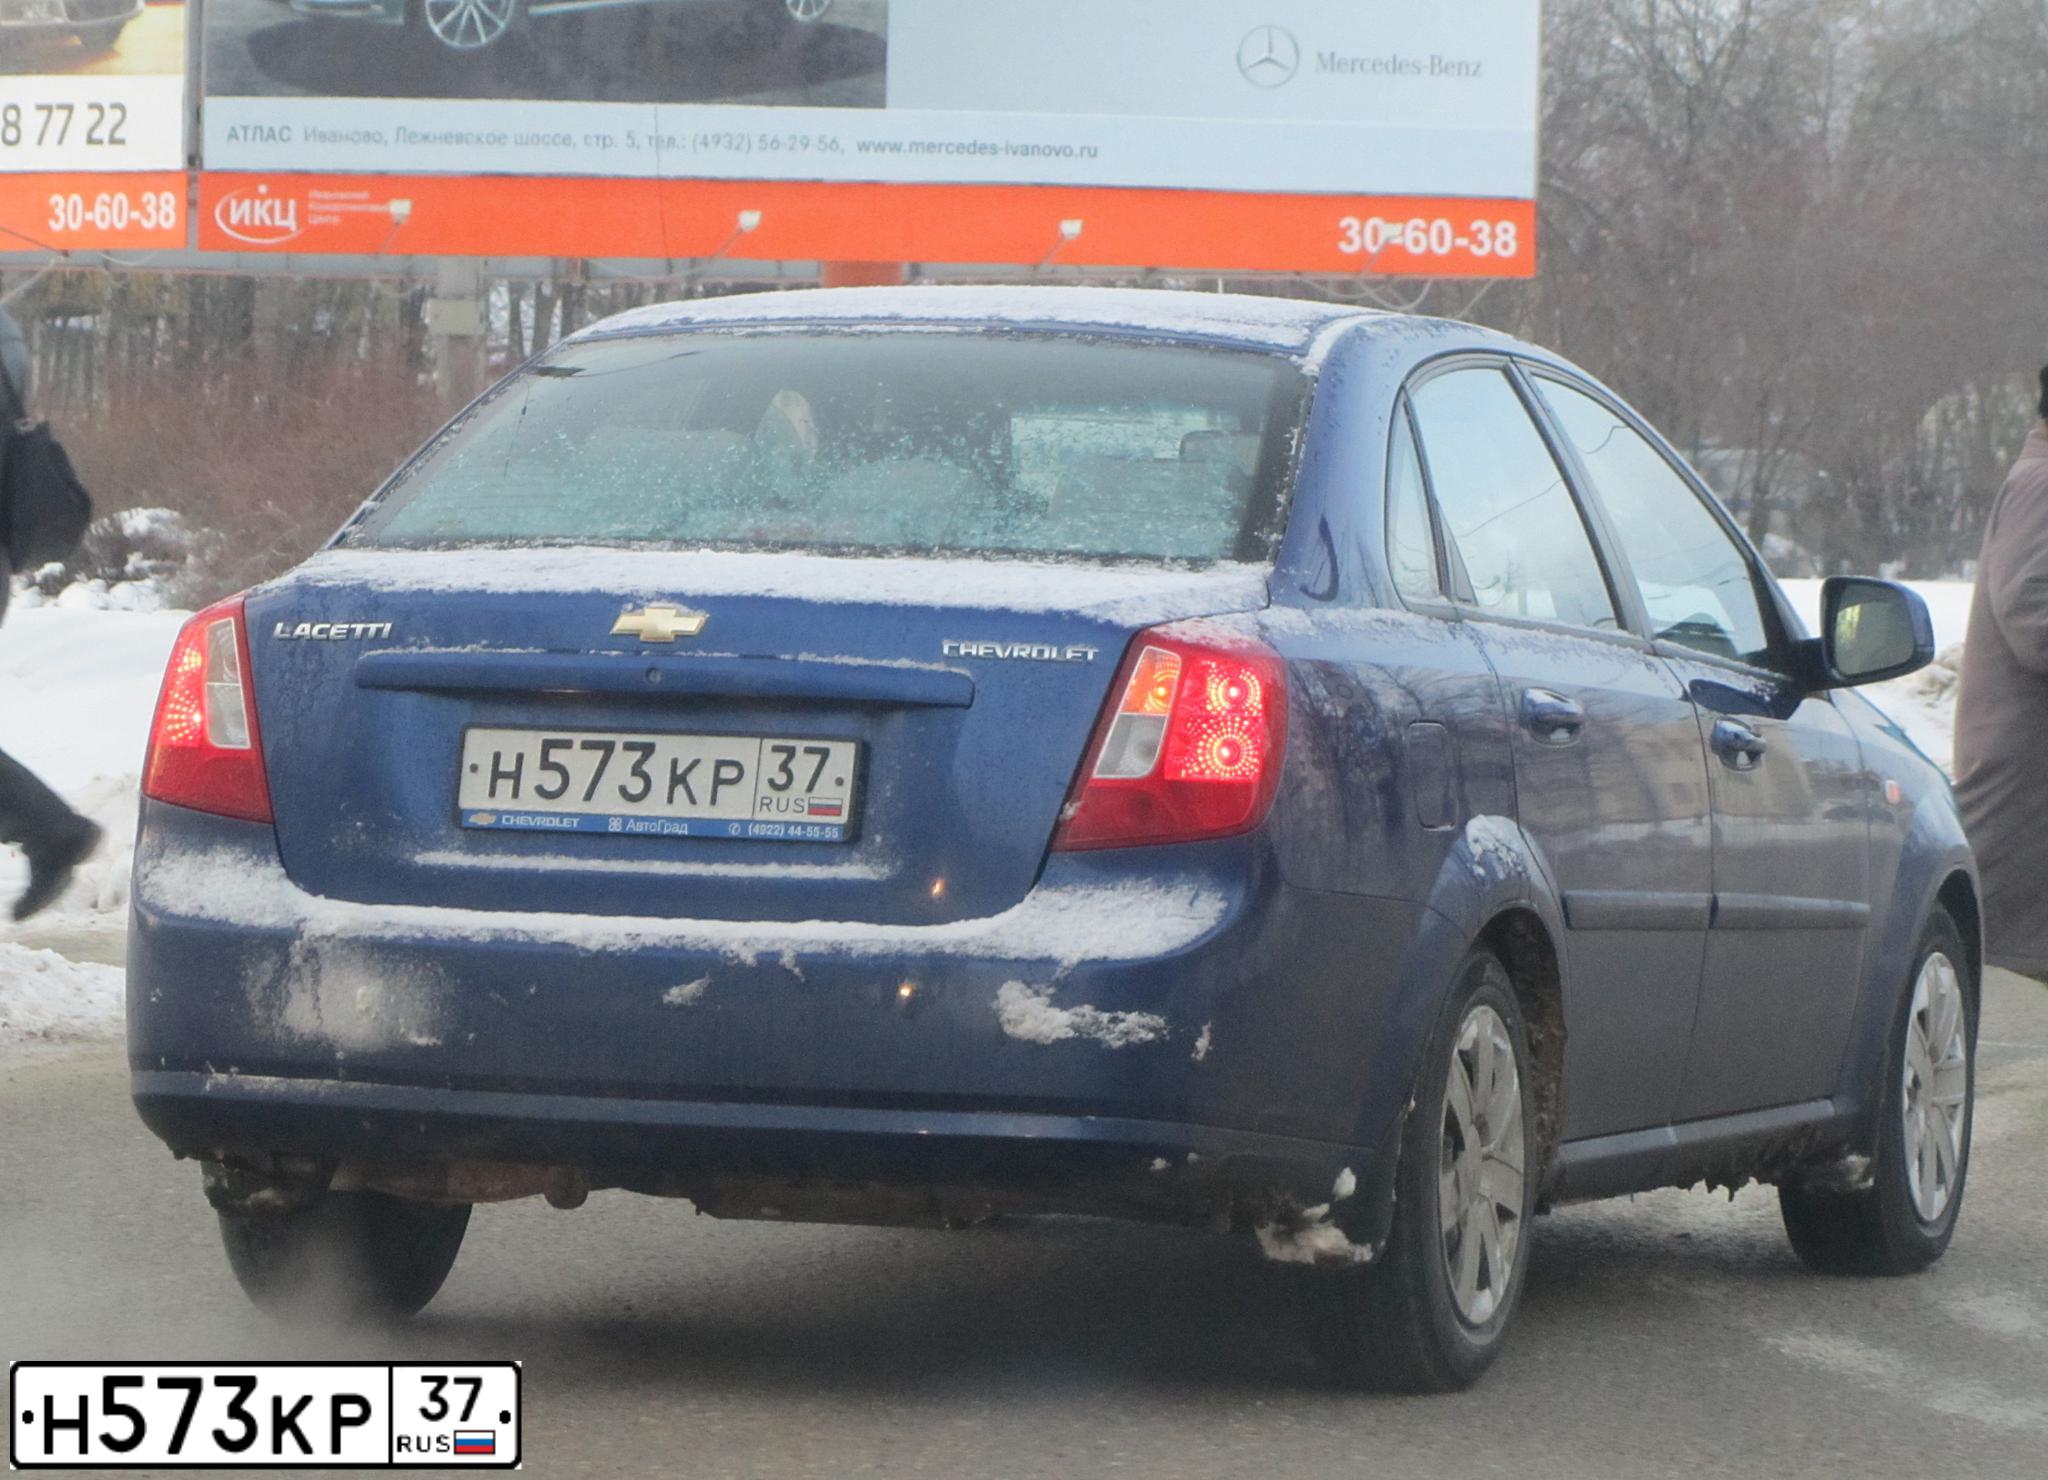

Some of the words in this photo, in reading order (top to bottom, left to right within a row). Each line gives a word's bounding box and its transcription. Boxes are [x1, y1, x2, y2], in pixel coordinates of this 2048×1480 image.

[1315, 51, 1483, 78] Mercedes-Benz
[35, 104, 74, 146] 77
[85, 102, 128, 146] 22
[226, 125, 293, 144] АТЛАС
[303, 126, 389, 147] Иваново,
[395, 126, 509, 145] Лежневское
[513, 131, 577, 148] шоссе,
[583, 133, 618, 151] стр.
[692, 132, 752, 154] (4932)
[758, 133, 845, 155] 56-29-56,
[855, 139, 1099, 159] www.mercedes-ivanovo.ru
[48, 192, 176, 232] 30-60-38
[229, 197, 297, 232] ИКЦ
[1337, 216, 1518, 257] 30-60-38
[273, 621, 393, 641] LACETTI
[941, 640, 1100, 662] CHEVROLET
[766, 745, 831, 794] 37
[759, 796, 806, 814] RUS
[501, 814, 580, 829] CHEVROLET
[625, 821, 689, 836] АвтоГрад
[748, 824, 785, 838] (4922)
[788, 825, 840, 840] 44-55-55
